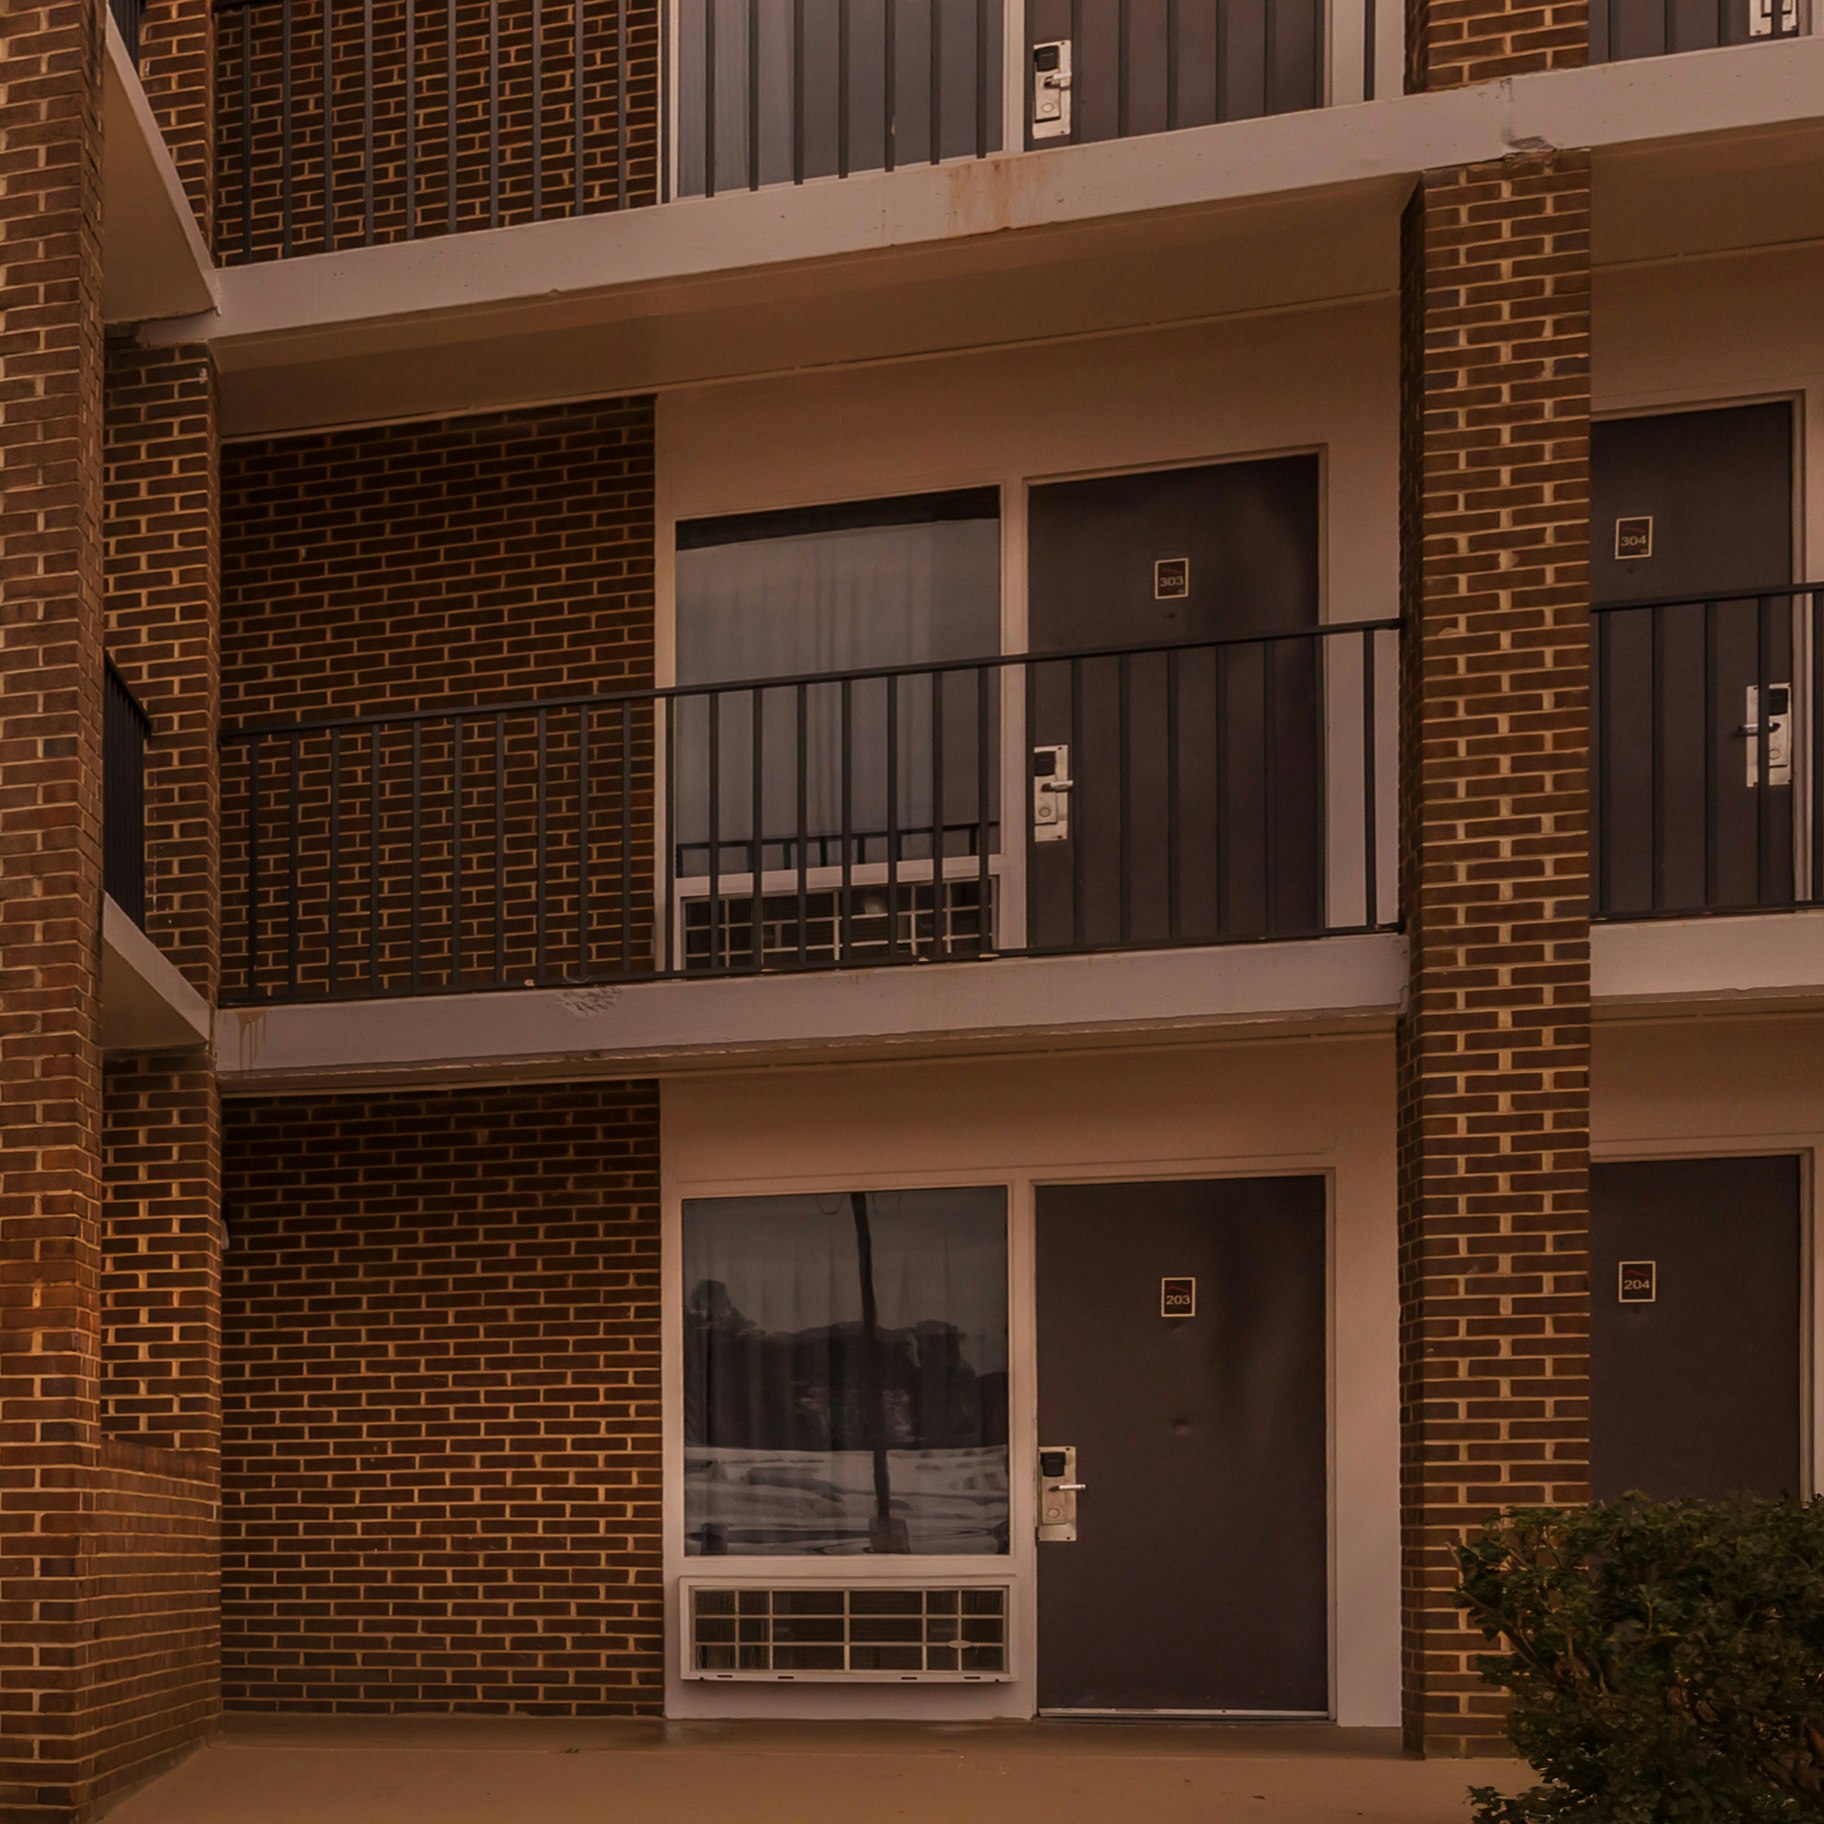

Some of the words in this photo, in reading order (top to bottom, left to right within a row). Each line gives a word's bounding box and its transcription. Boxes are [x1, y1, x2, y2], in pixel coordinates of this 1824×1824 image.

[1620, 535, 1647, 547] 304
[1159, 576, 1184, 588] 303
[1623, 1279, 1650, 1291] 204
[1165, 1294, 1191, 1305] 203
